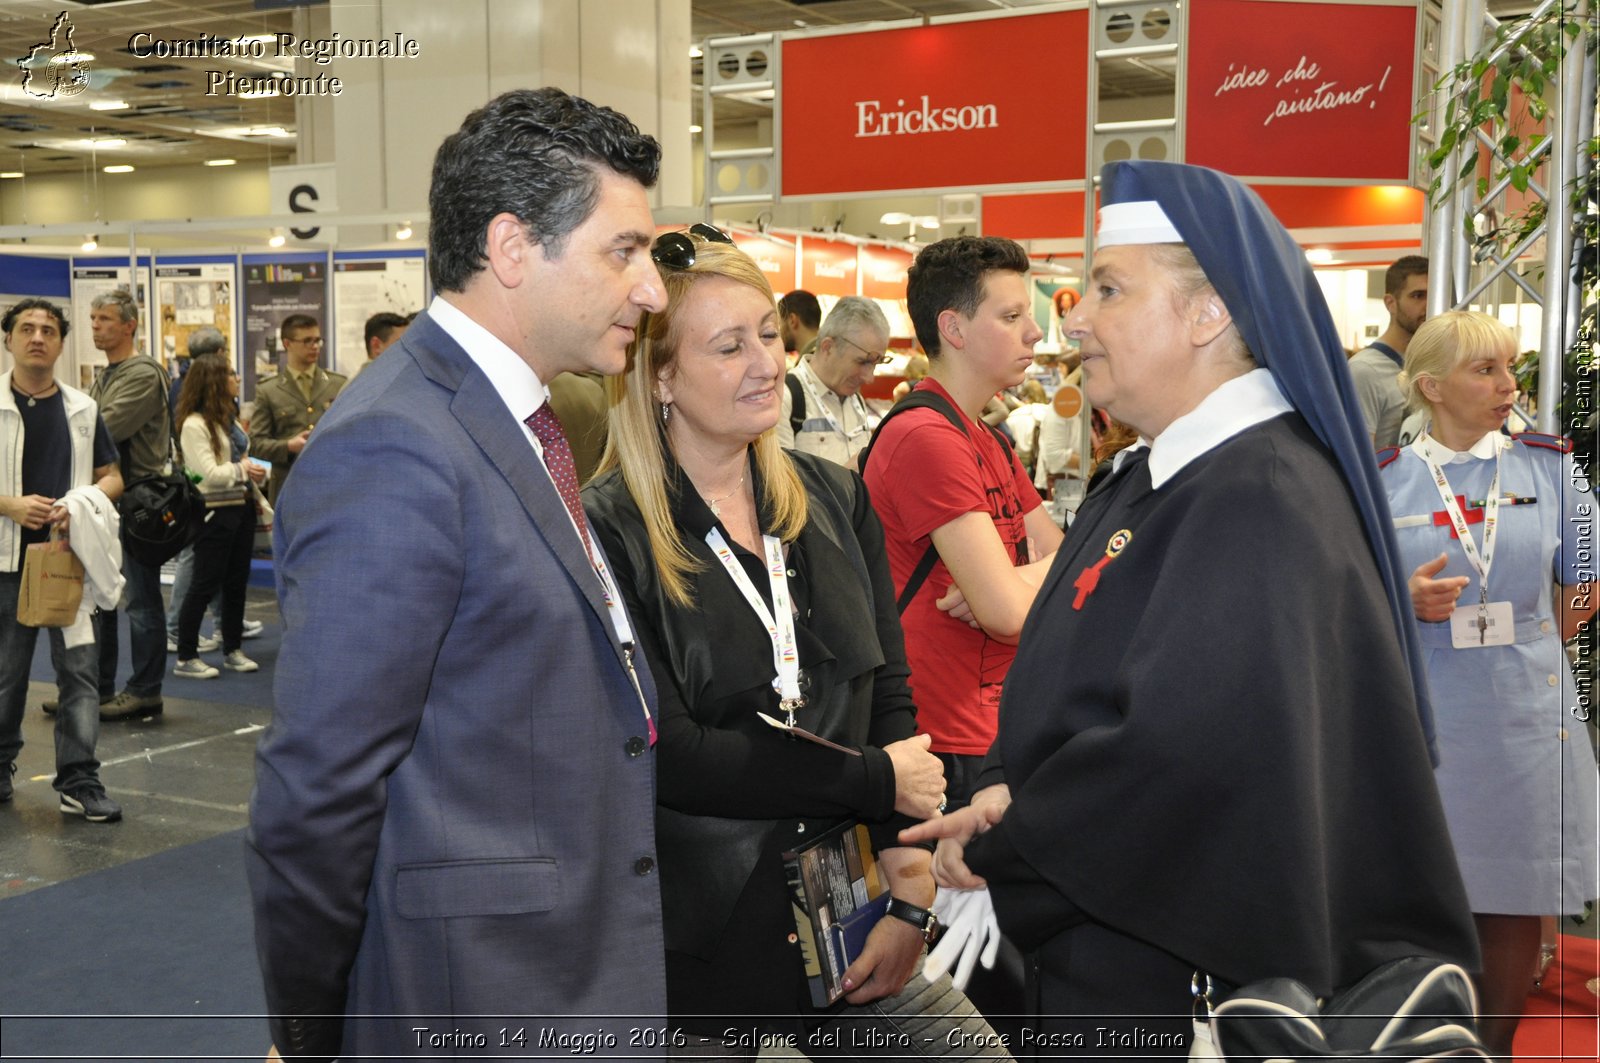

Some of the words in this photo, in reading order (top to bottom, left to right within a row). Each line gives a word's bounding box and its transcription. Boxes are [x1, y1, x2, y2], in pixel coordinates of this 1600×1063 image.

[1214, 63, 1270, 97] idee
[1275, 55, 1321, 88] che
[854, 95, 999, 138] Erickson
[289, 184, 320, 239] S
